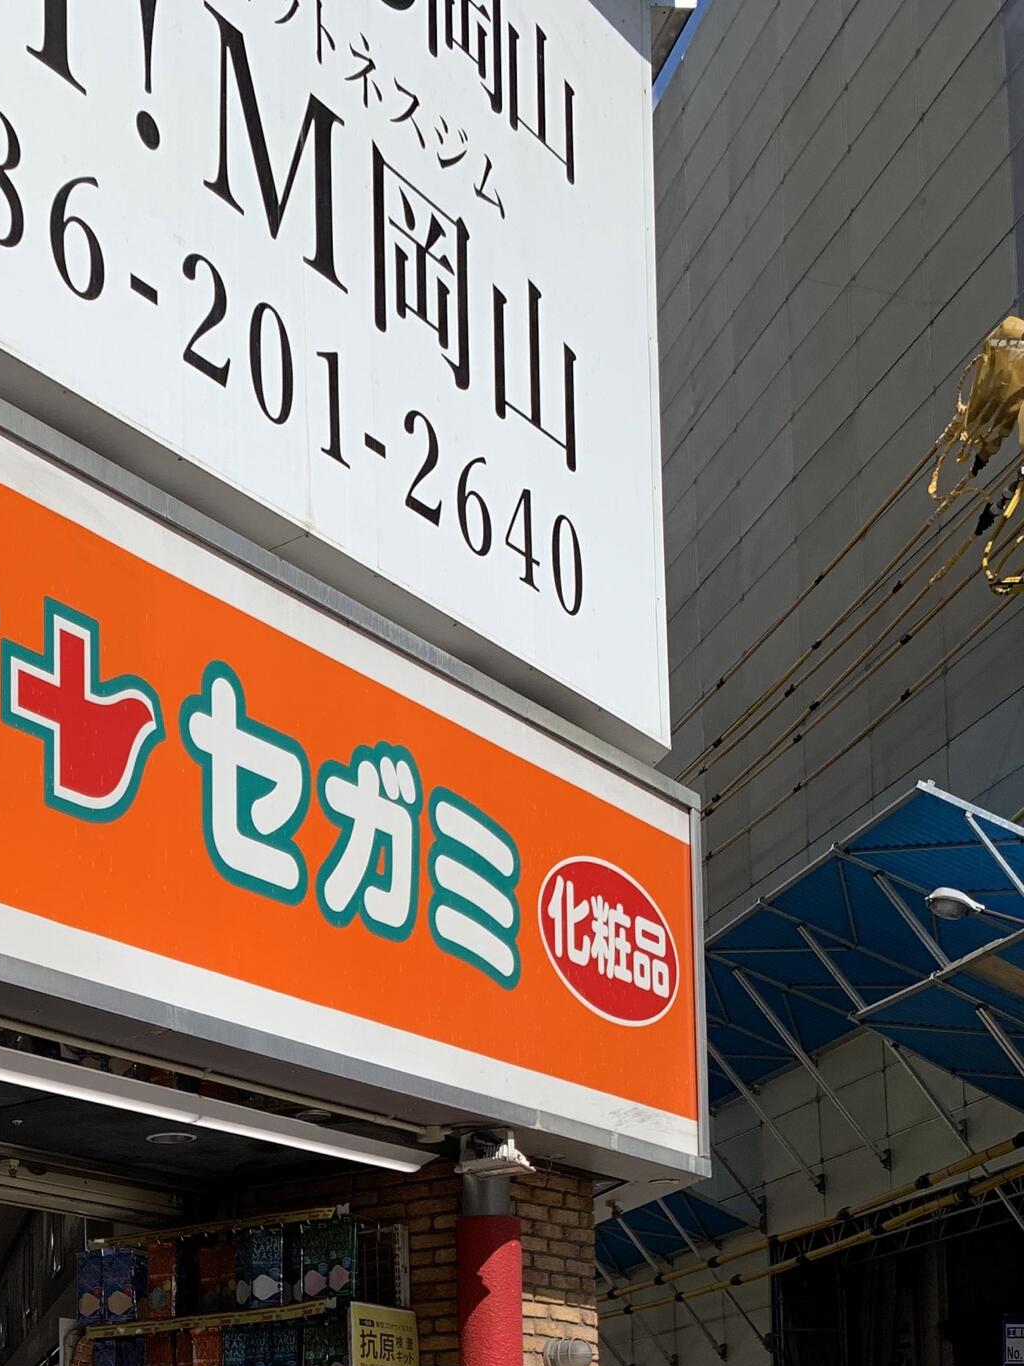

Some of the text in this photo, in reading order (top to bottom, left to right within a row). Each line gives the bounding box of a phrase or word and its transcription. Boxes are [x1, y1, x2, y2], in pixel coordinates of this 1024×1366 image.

[183, 662, 520, 988] セガミ
[547, 875, 670, 998] 化粧品
[360, 1329, 395, 1362] 抗原
